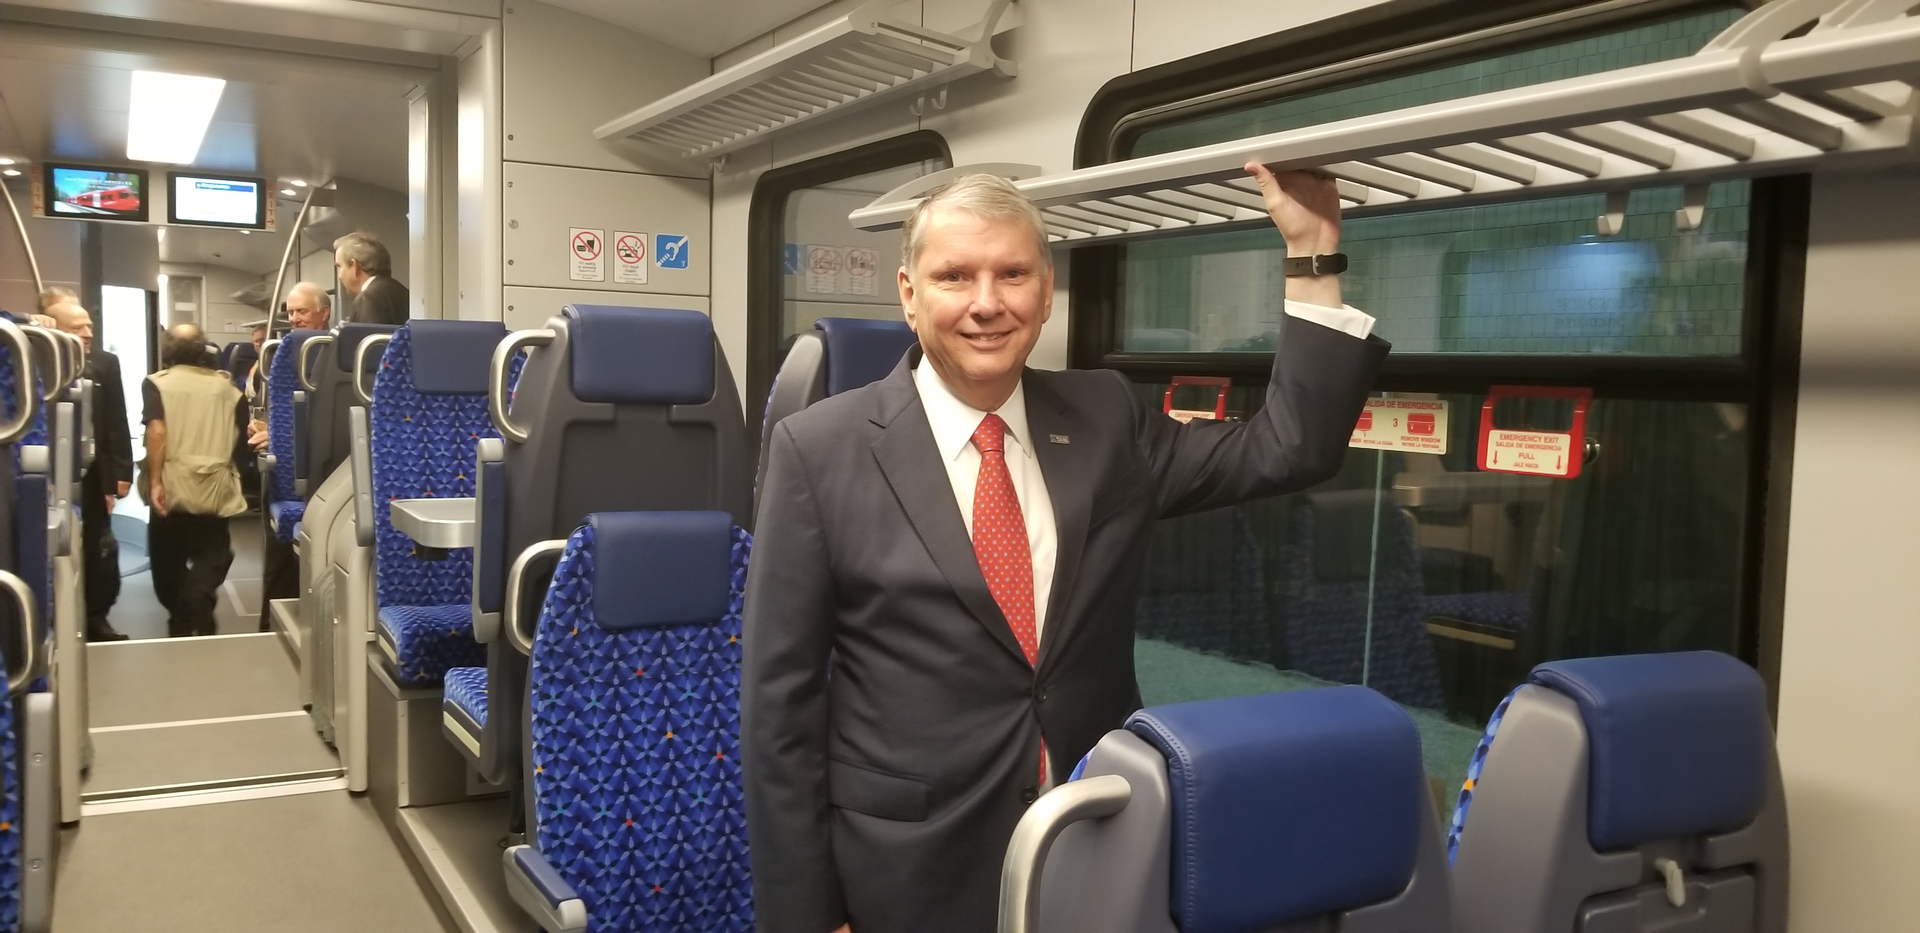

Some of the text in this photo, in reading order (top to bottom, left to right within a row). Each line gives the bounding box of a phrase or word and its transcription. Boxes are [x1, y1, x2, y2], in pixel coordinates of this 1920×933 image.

[1365, 400, 1444, 410] ALIDA DE EMERGENCIA
[1392, 418, 1399, 427] 3
[1499, 433, 1559, 444] EMERGENCY EXIT
[1524, 443, 1562, 451] EMERGENCIA
[1518, 452, 1535, 460] PULL
